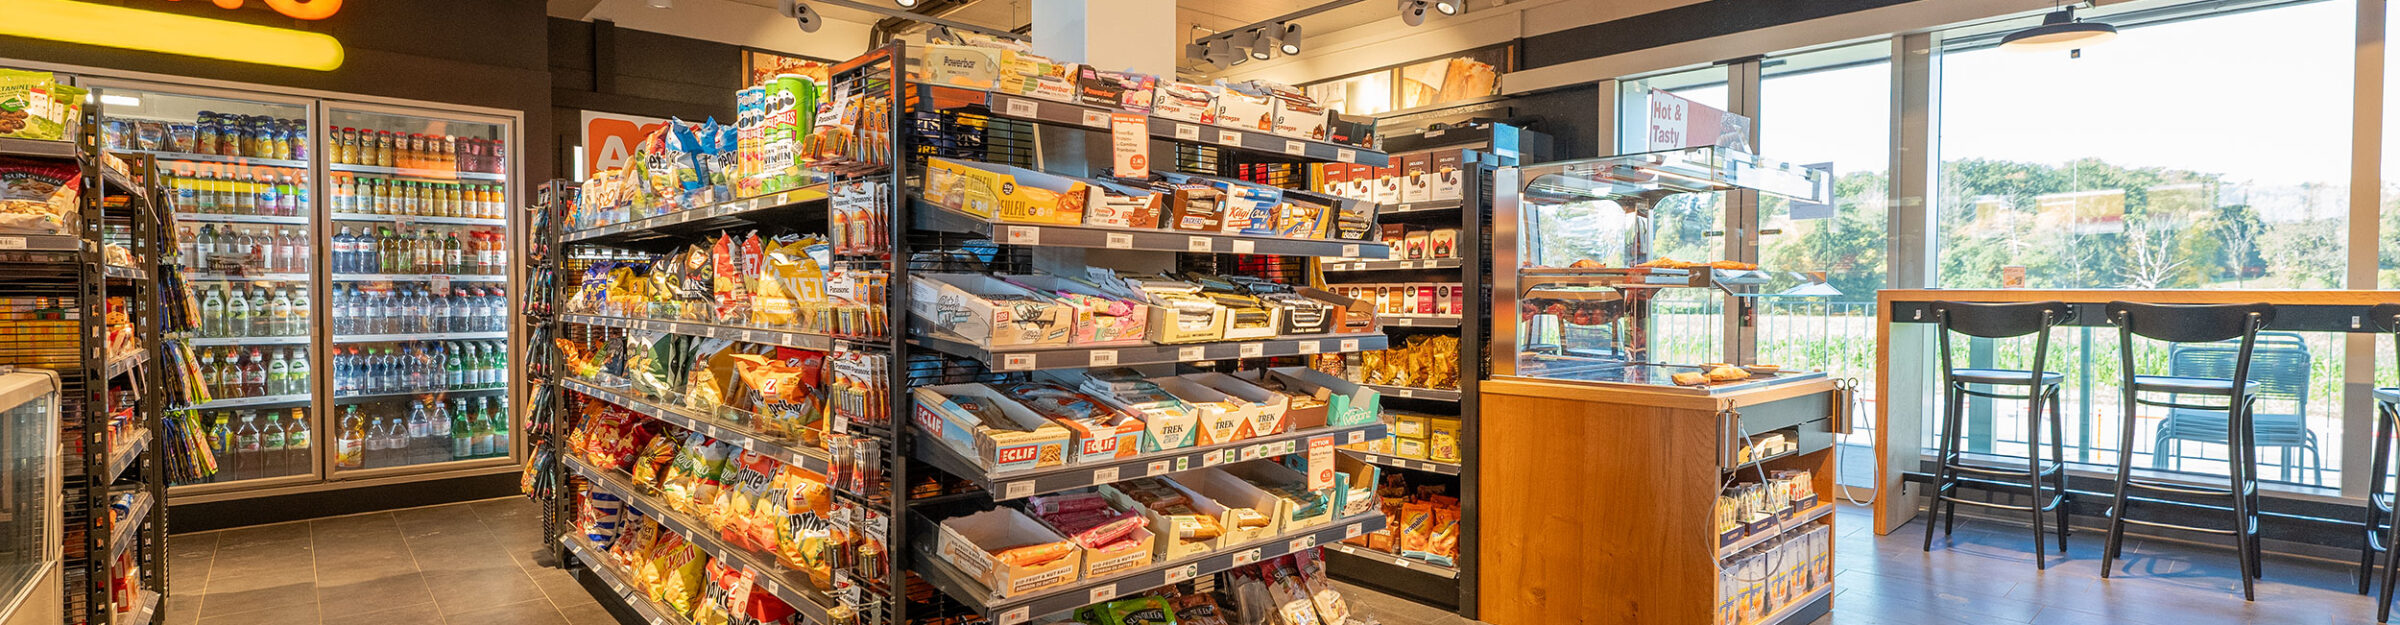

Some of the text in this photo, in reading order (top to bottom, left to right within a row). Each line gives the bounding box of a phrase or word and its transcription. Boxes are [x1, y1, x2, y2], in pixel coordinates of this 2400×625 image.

[943, 56, 976, 69] Powerbar
[1038, 83, 1070, 93] Powerbar
[1653, 101, 1682, 121] Hot &
[1653, 125, 1680, 147] Tasty
[4, 172, 62, 186] SUN QUEEN
[1000, 199, 1026, 216] FULFIL
[829, 286, 850, 294] Panasonic
[922, 410, 942, 432] CLIF
[1257, 413, 1276, 422] TREK
[1345, 410, 1372, 425] Veganz
[1162, 424, 1184, 435] TREK
[1215, 420, 1234, 430] TREK
[1008, 447, 1036, 461] CLIF
